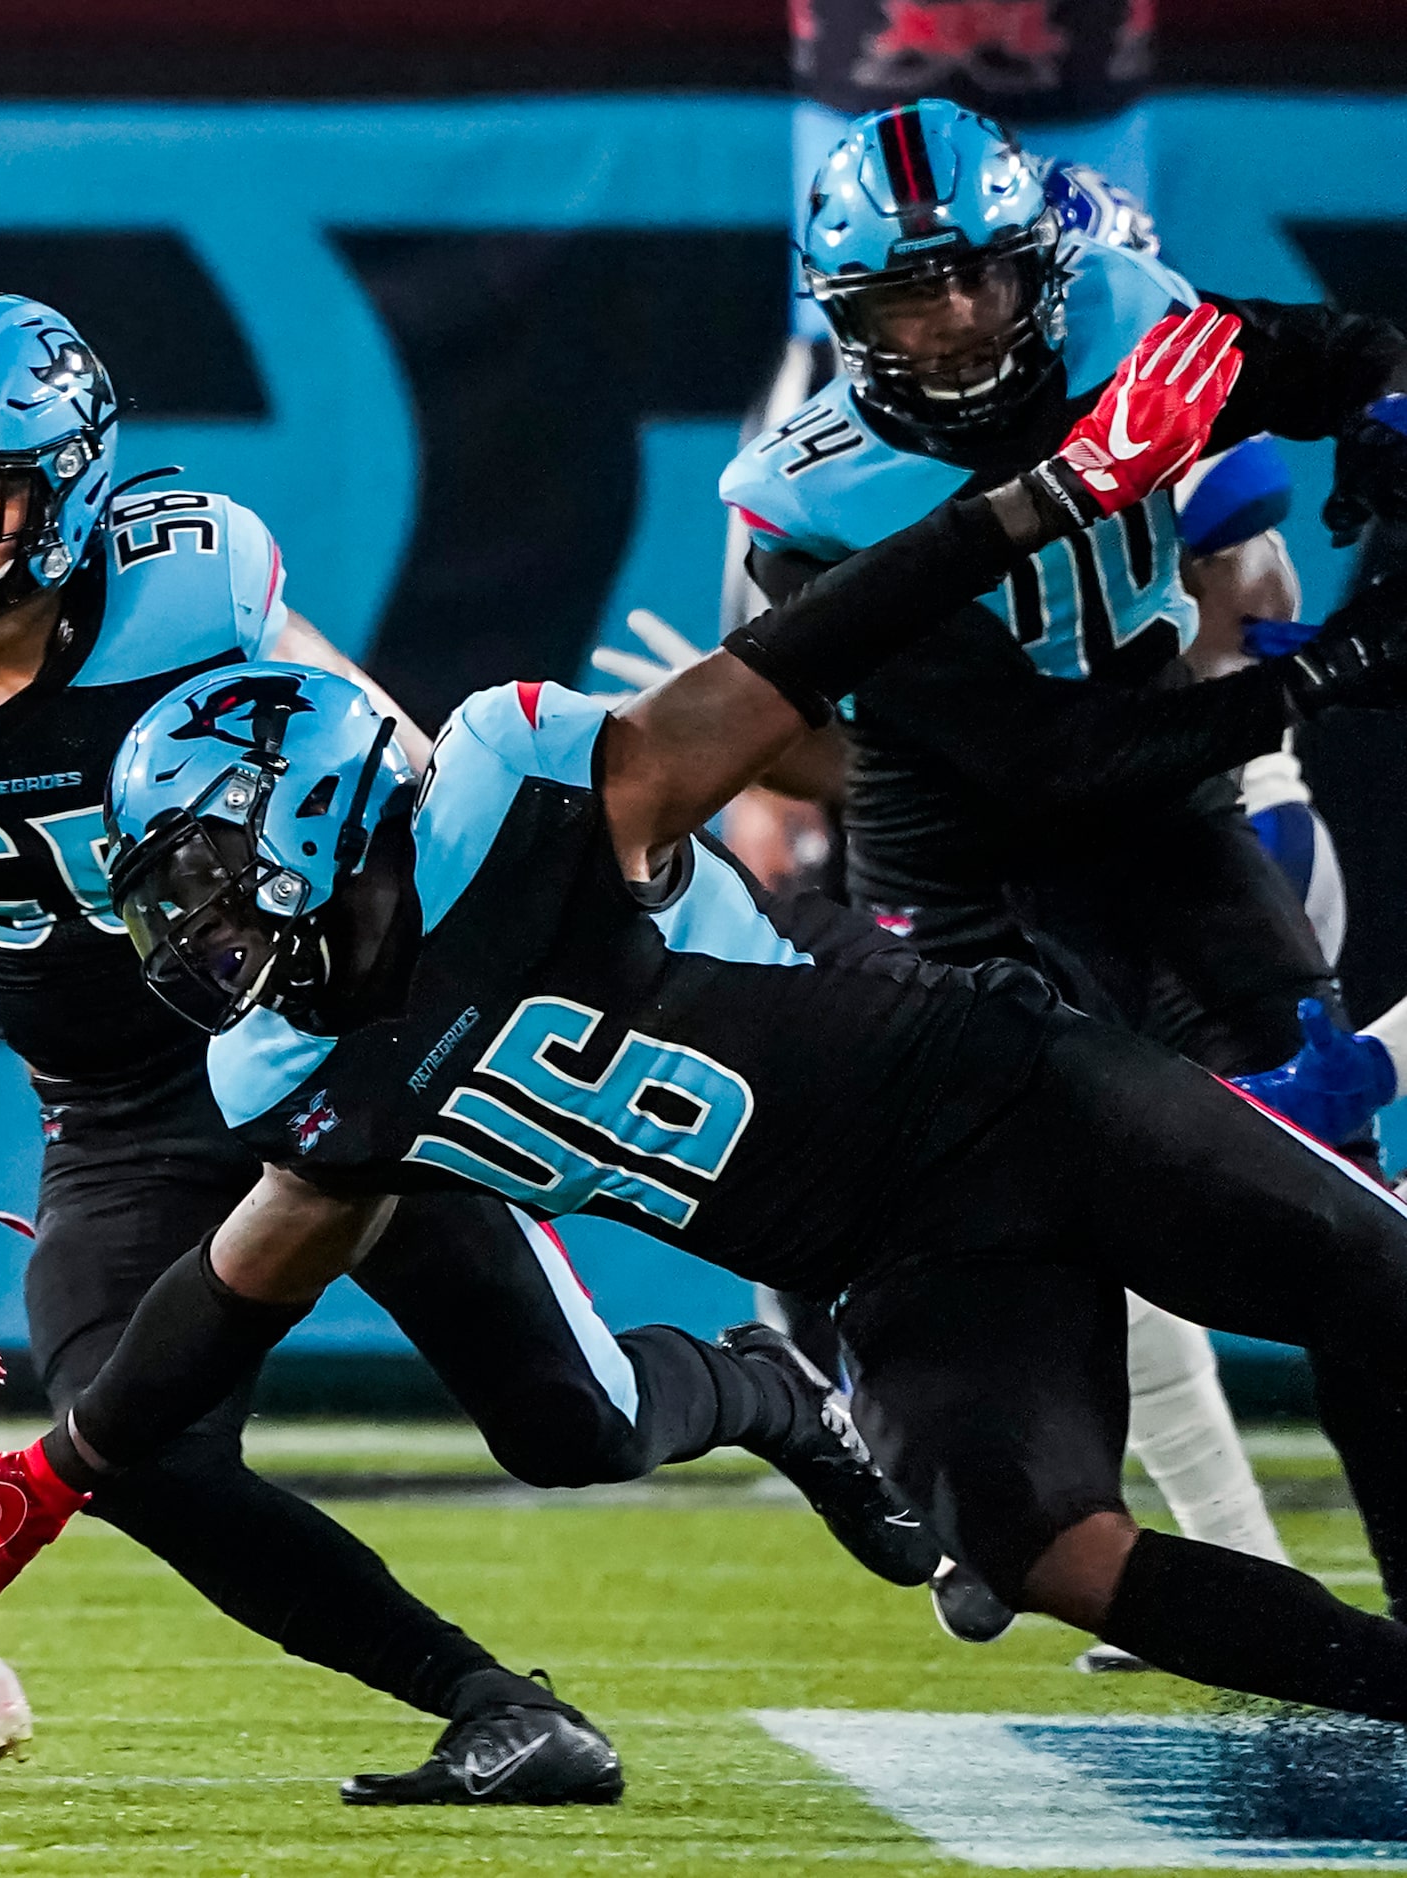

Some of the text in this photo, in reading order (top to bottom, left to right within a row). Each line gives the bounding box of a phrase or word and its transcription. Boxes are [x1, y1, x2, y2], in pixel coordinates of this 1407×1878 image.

[755, 402, 865, 480] 44
[109, 490, 219, 575] 58
[406, 1005, 481, 1095] RENEGADES
[401, 994, 755, 1230] 46
